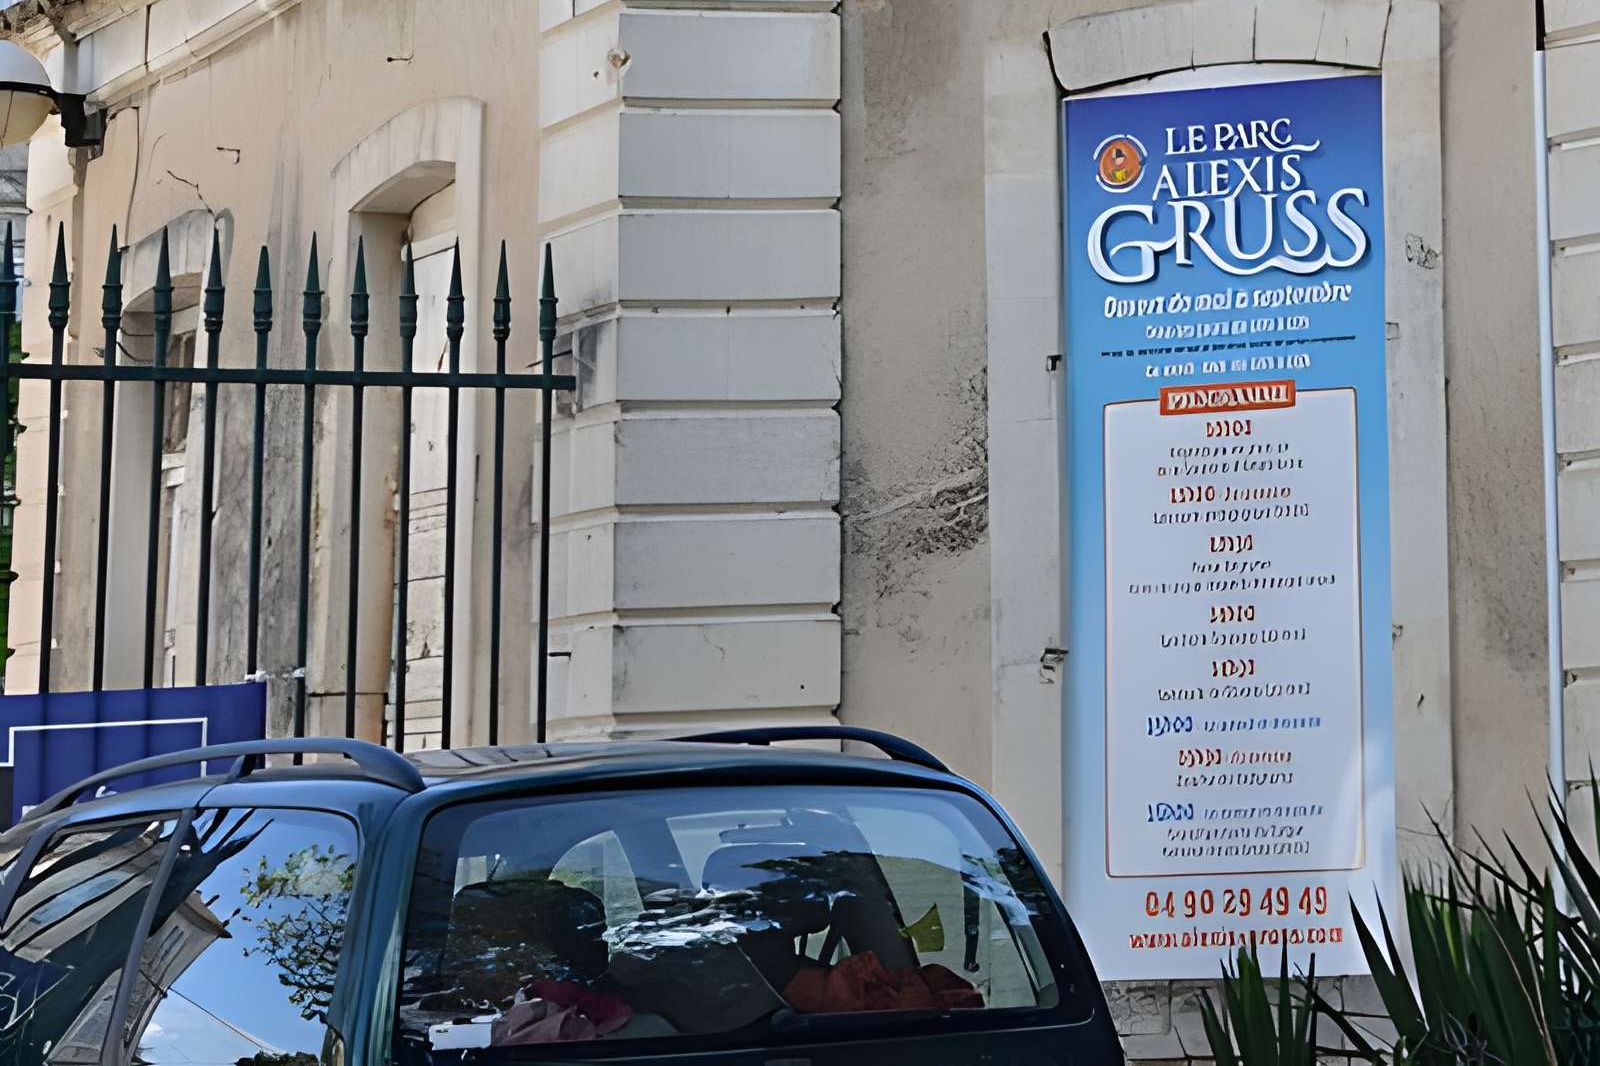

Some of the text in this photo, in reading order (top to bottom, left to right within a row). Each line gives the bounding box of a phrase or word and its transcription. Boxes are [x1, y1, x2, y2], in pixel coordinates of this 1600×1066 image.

[1164, 118, 1321, 156] LE PARC
[1152, 155, 1302, 201] ALEXIS
[1087, 188, 1368, 284] GRUSS
[1145, 885, 1328, 918] 04 90 29 49 49
